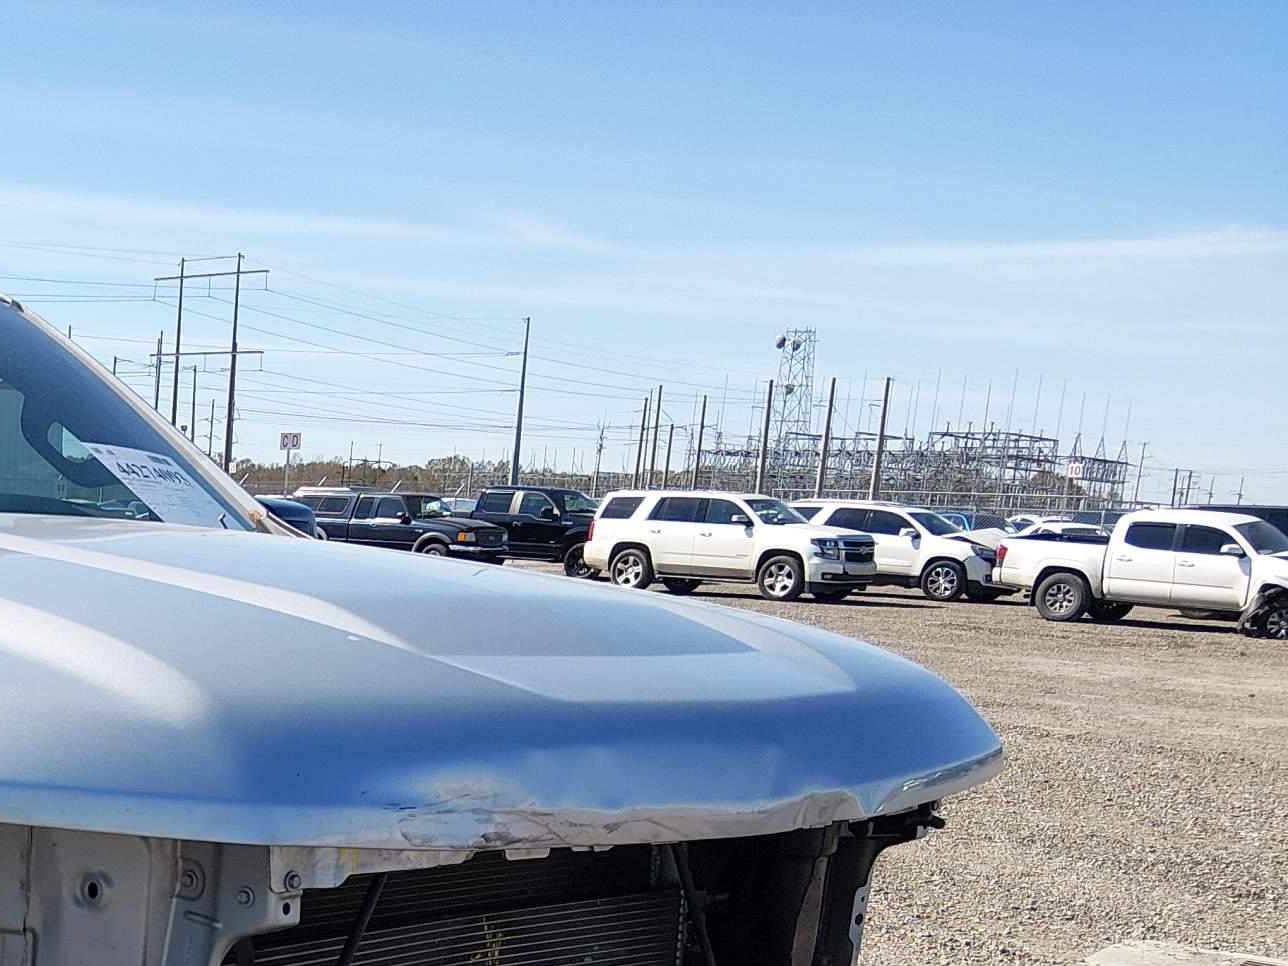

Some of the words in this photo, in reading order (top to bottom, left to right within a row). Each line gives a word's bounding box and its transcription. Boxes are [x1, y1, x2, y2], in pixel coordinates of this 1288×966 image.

[282, 434, 289, 448] C
[292, 434, 299, 448] D
[1069, 465, 1081, 476] 10
